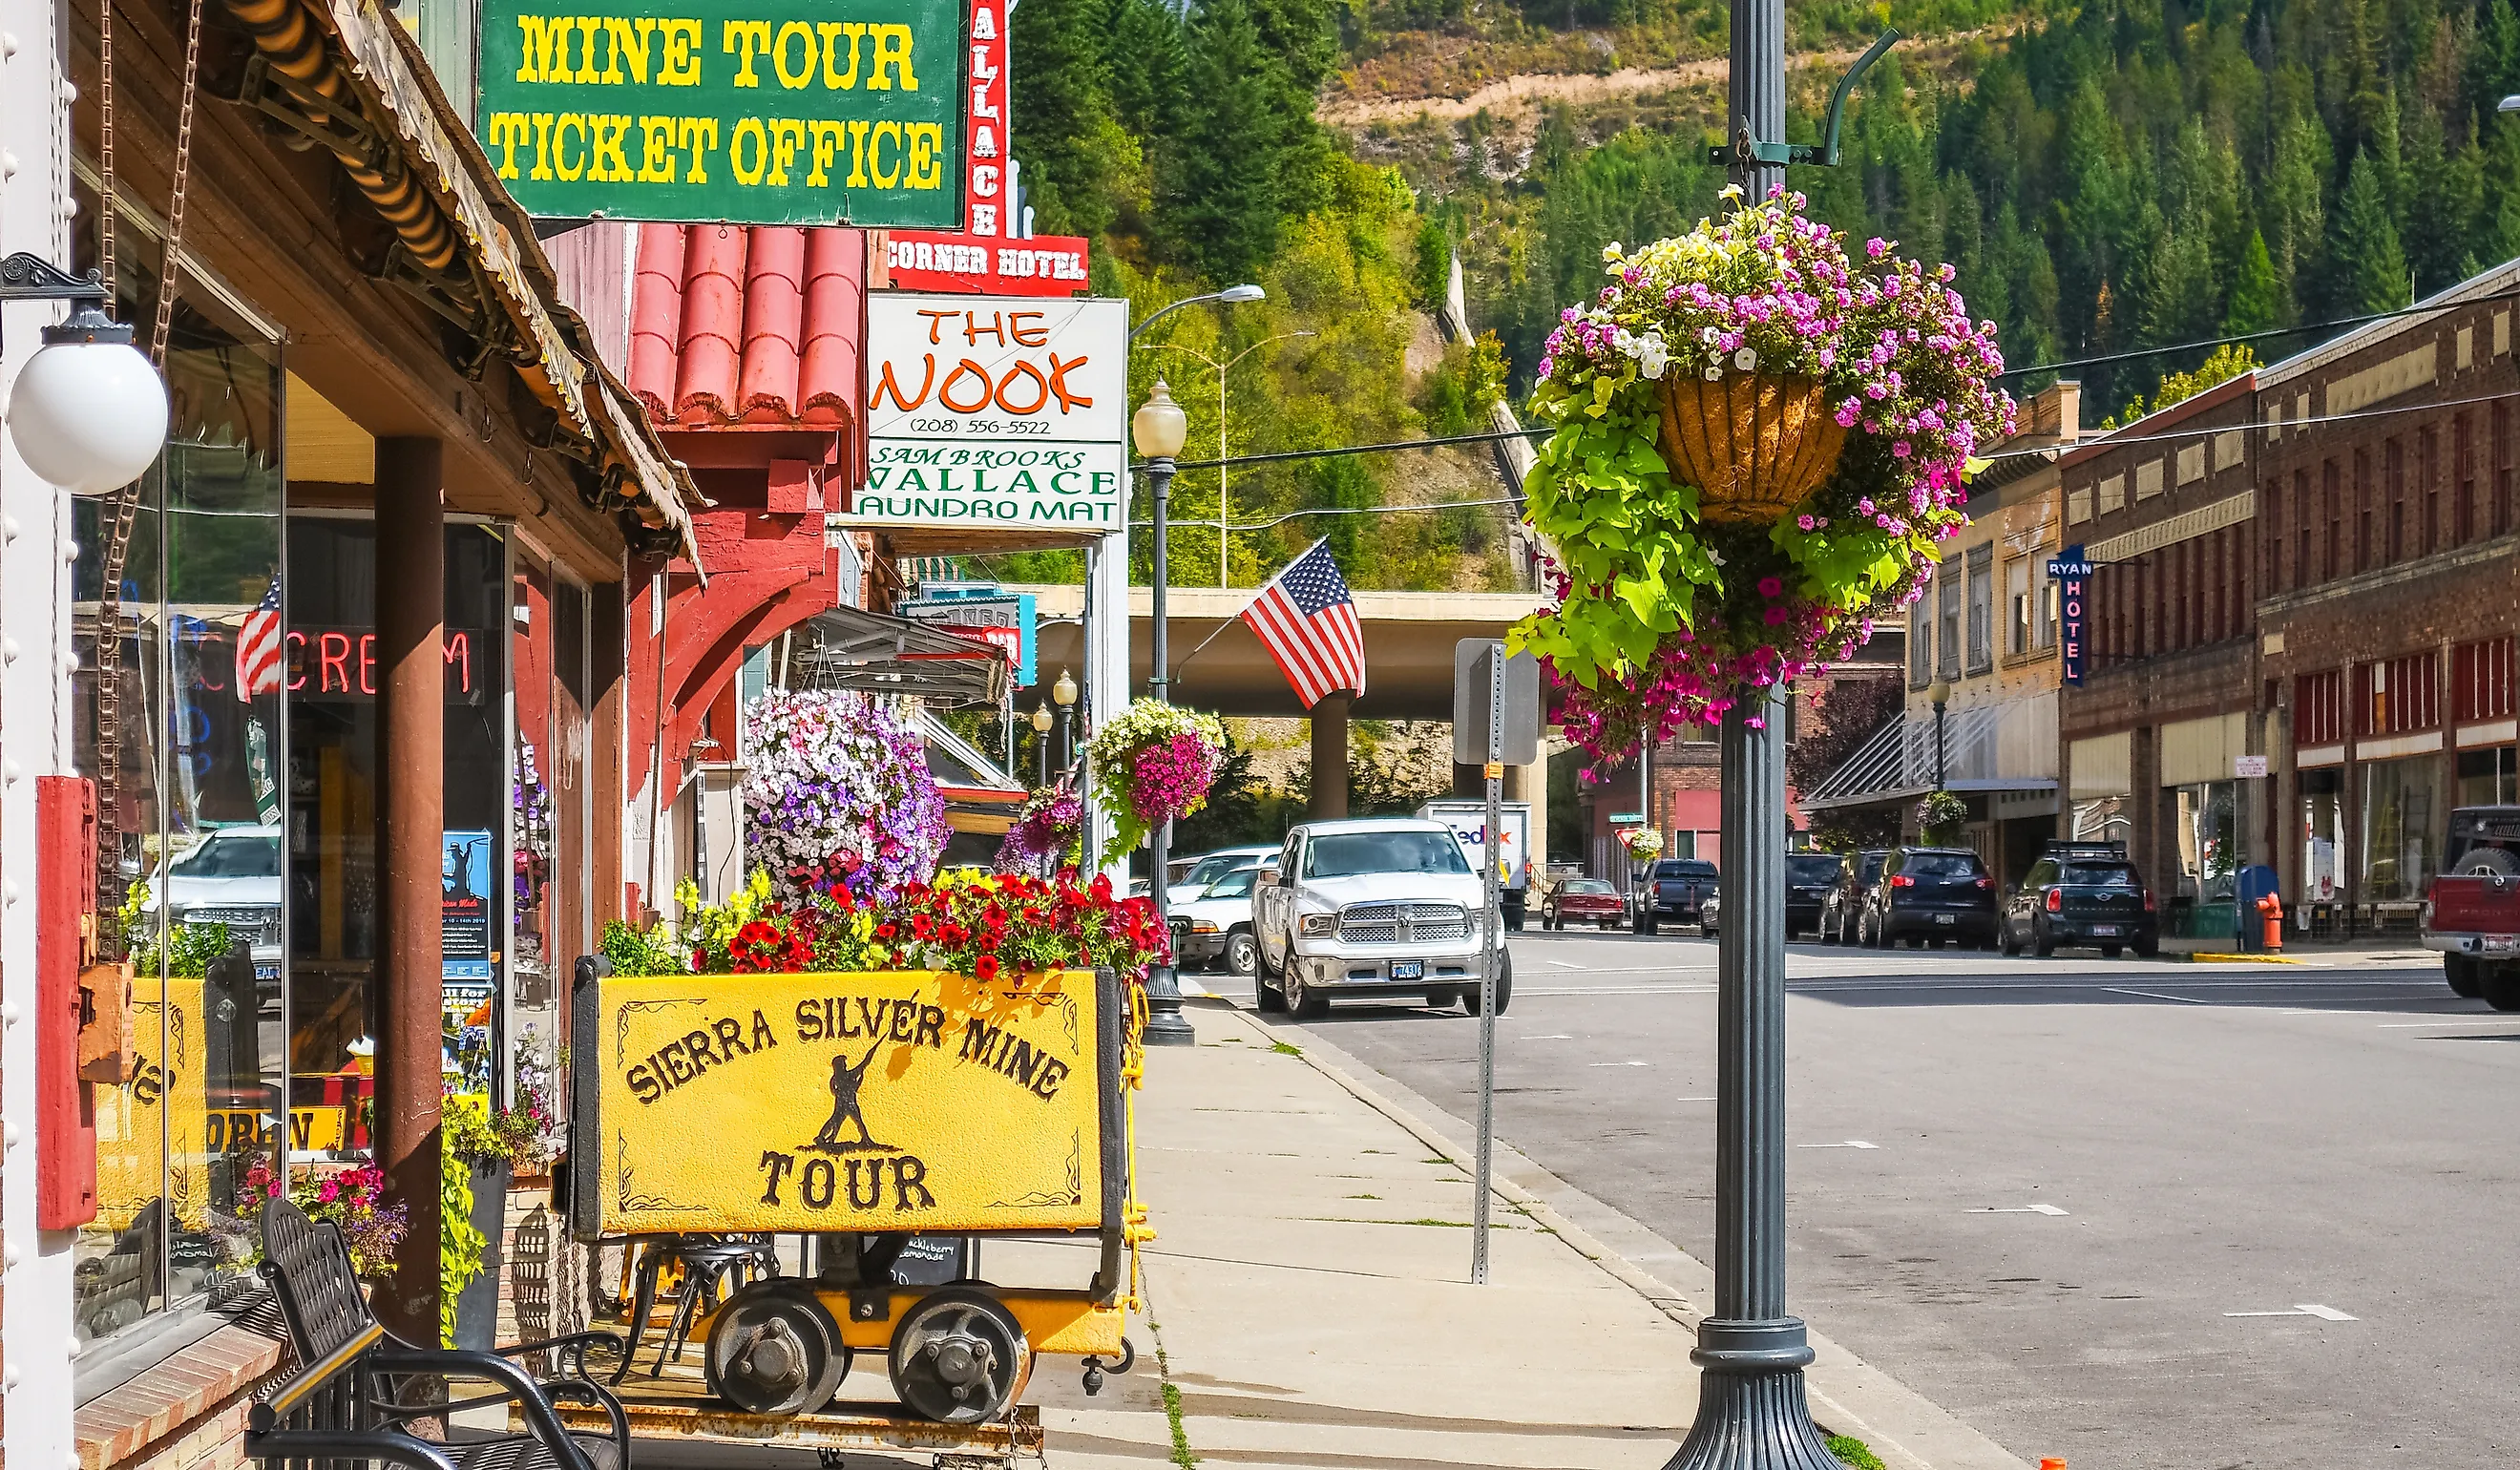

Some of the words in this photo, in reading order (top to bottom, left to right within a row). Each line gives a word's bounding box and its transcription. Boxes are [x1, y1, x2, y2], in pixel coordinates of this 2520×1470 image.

[515, 14, 703, 87] MINE
[723, 19, 919, 92] TOUR
[972, 0, 1000, 236] ALLACE
[489, 112, 718, 185] TICKET
[728, 116, 942, 190] OFFICE
[888, 240, 989, 275] CORNER
[997, 248, 1087, 281] HOTEL
[916, 309, 1051, 347] THE
[869, 352, 1094, 414] NOOK
[910, 417, 959, 433] (208)
[965, 420, 1052, 435] 556-5522
[870, 447, 948, 466] SAM
[949, 449, 1086, 470] BROOKS
[849, 495, 1018, 519] AUNDRO
[1029, 501, 1117, 522] MAT
[2048, 563, 2092, 575] RYAN
[2066, 580, 2082, 679] HOTEL
[284, 631, 470, 695] CREM
[1449, 824, 1513, 846] edx
[442, 987, 458, 998] ll
[459, 987, 487, 998] for
[625, 1008, 779, 1106] SIERRA
[794, 995, 948, 1051] SILVER
[960, 1018, 1072, 1103] MINE
[759, 1149, 937, 1213] TOUR
